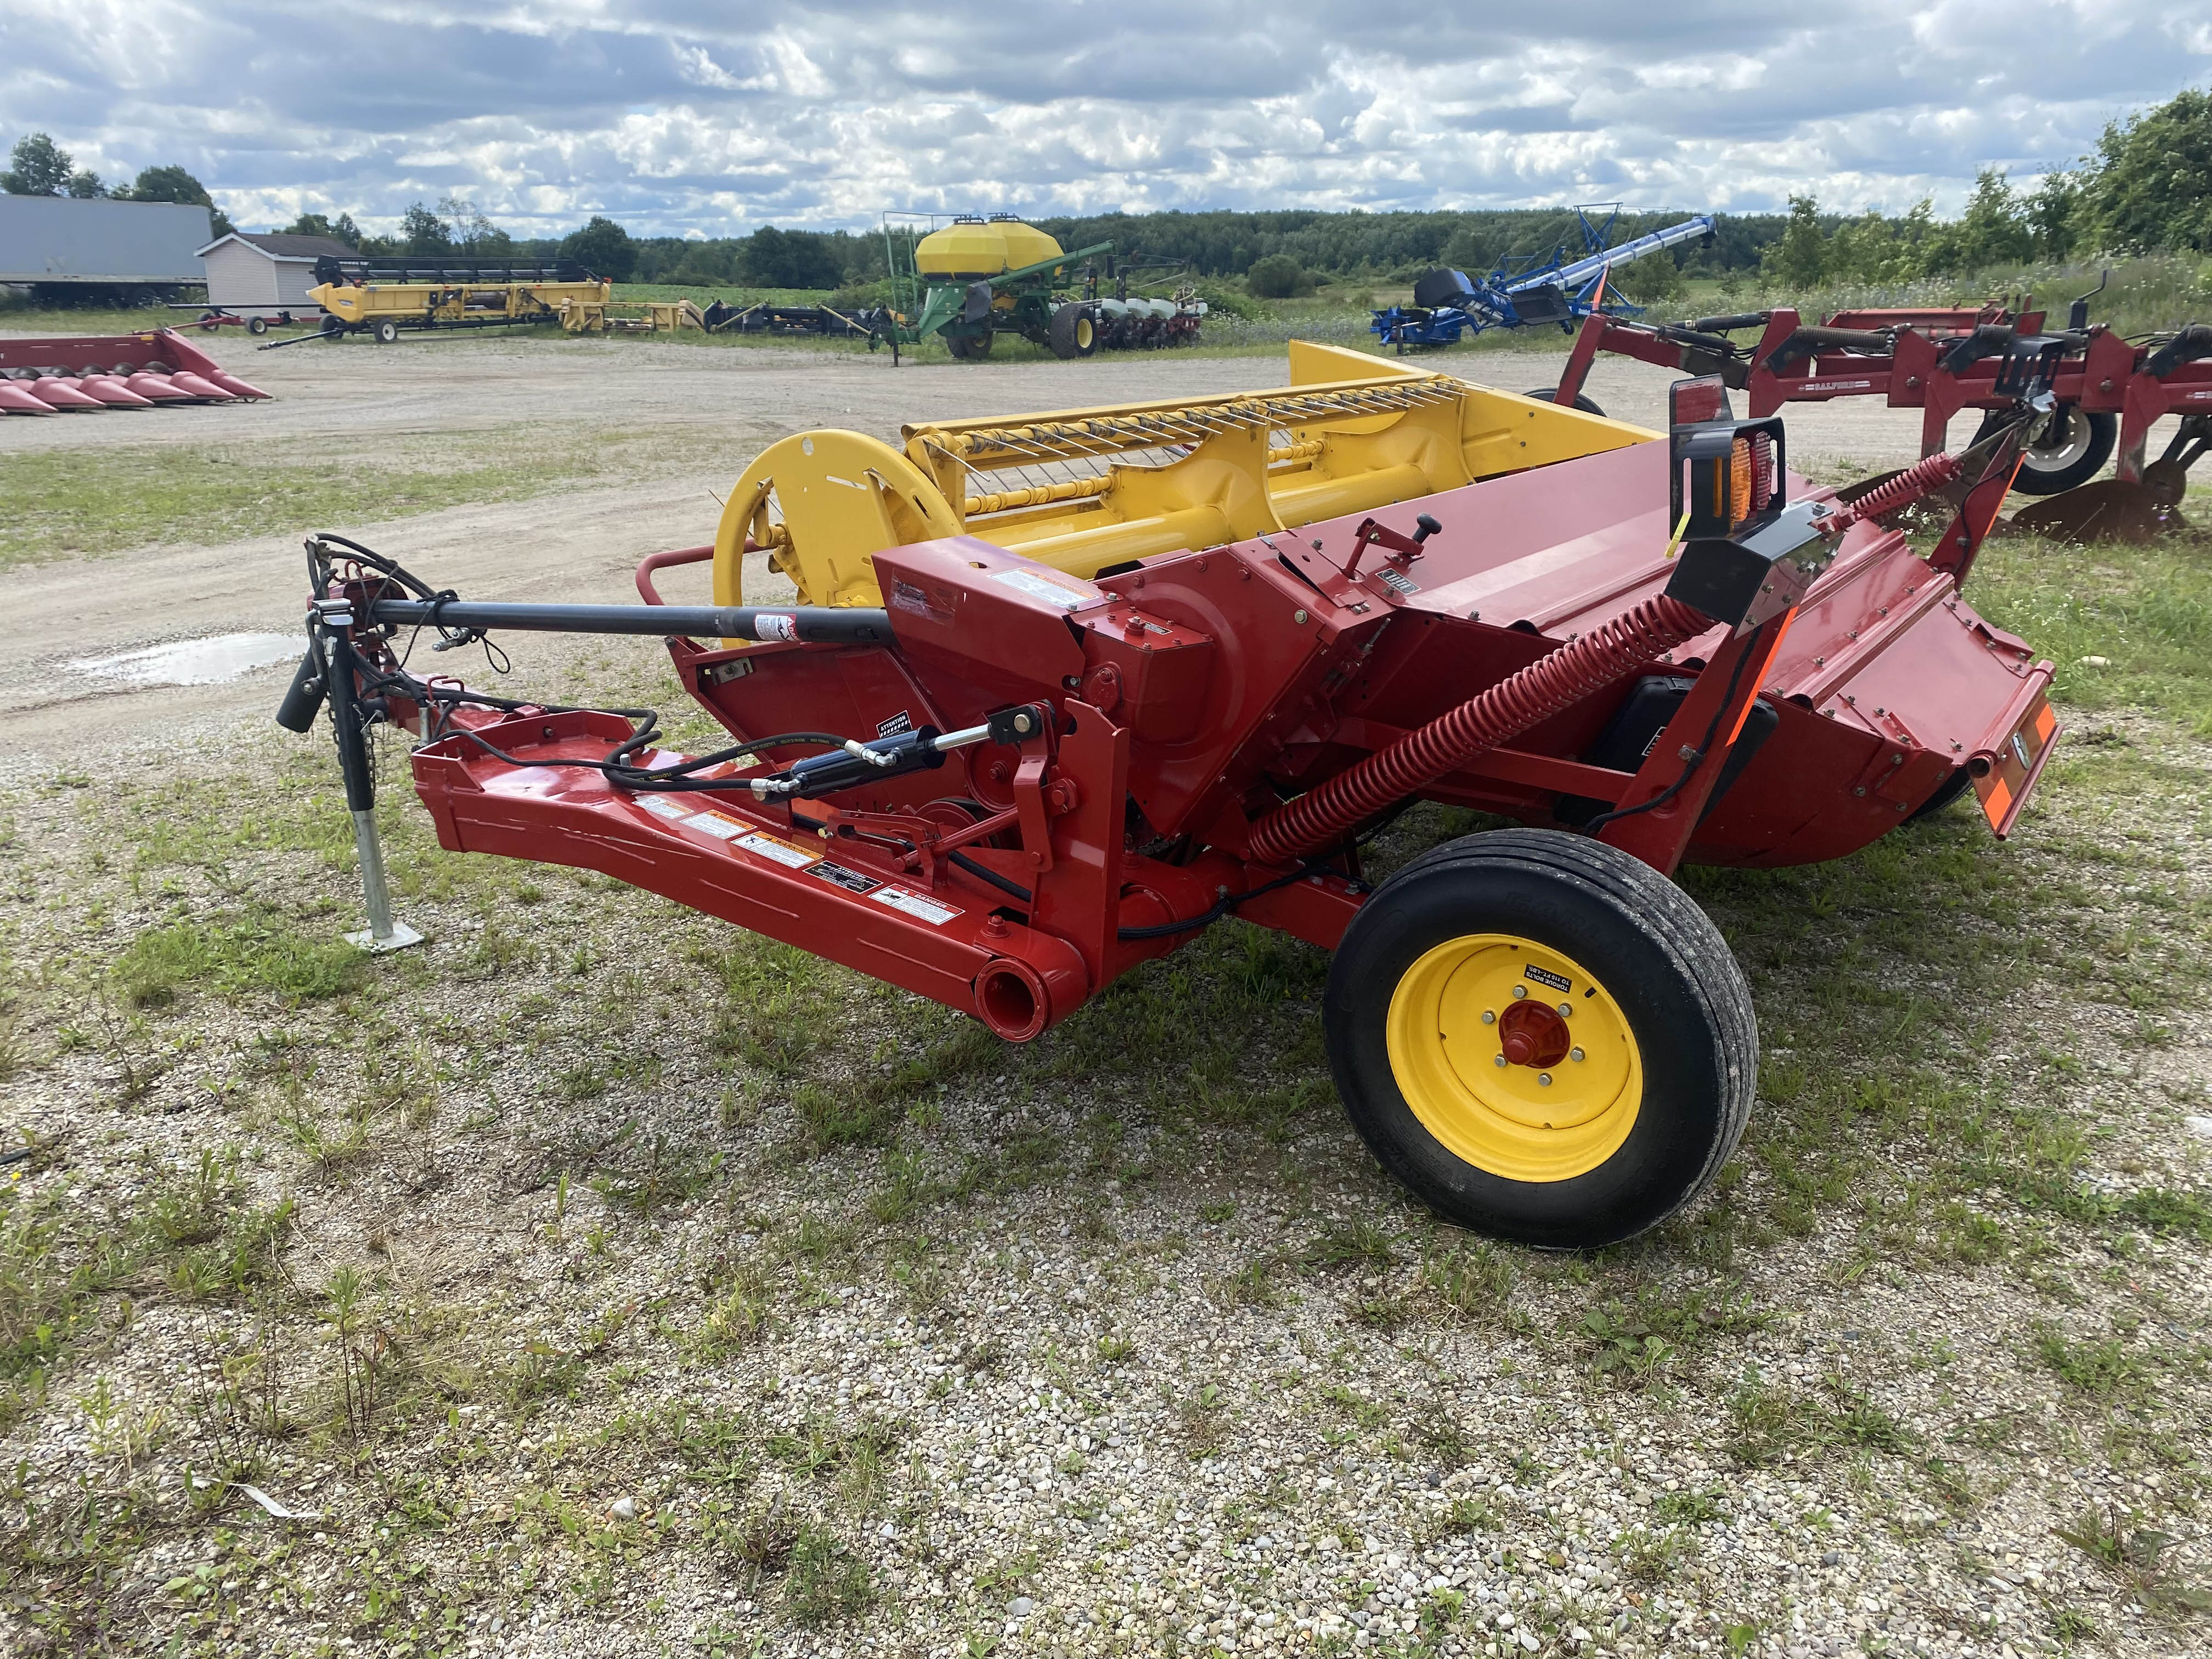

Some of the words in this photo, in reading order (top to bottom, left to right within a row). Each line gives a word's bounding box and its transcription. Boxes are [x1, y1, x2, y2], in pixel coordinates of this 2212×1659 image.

[1815, 381, 1855, 391] SALFORD
[881, 715, 906, 731] ATTENTION
[718, 814, 748, 828] WARNING
[775, 839, 811, 855] WARNING
[837, 866, 866, 879] ATTENTION
[913, 894, 948, 909] DANGER
[1526, 971, 1544, 983] BOLTS
[1561, 978, 1570, 986] TO
[1544, 979, 1568, 992] TORQUE
